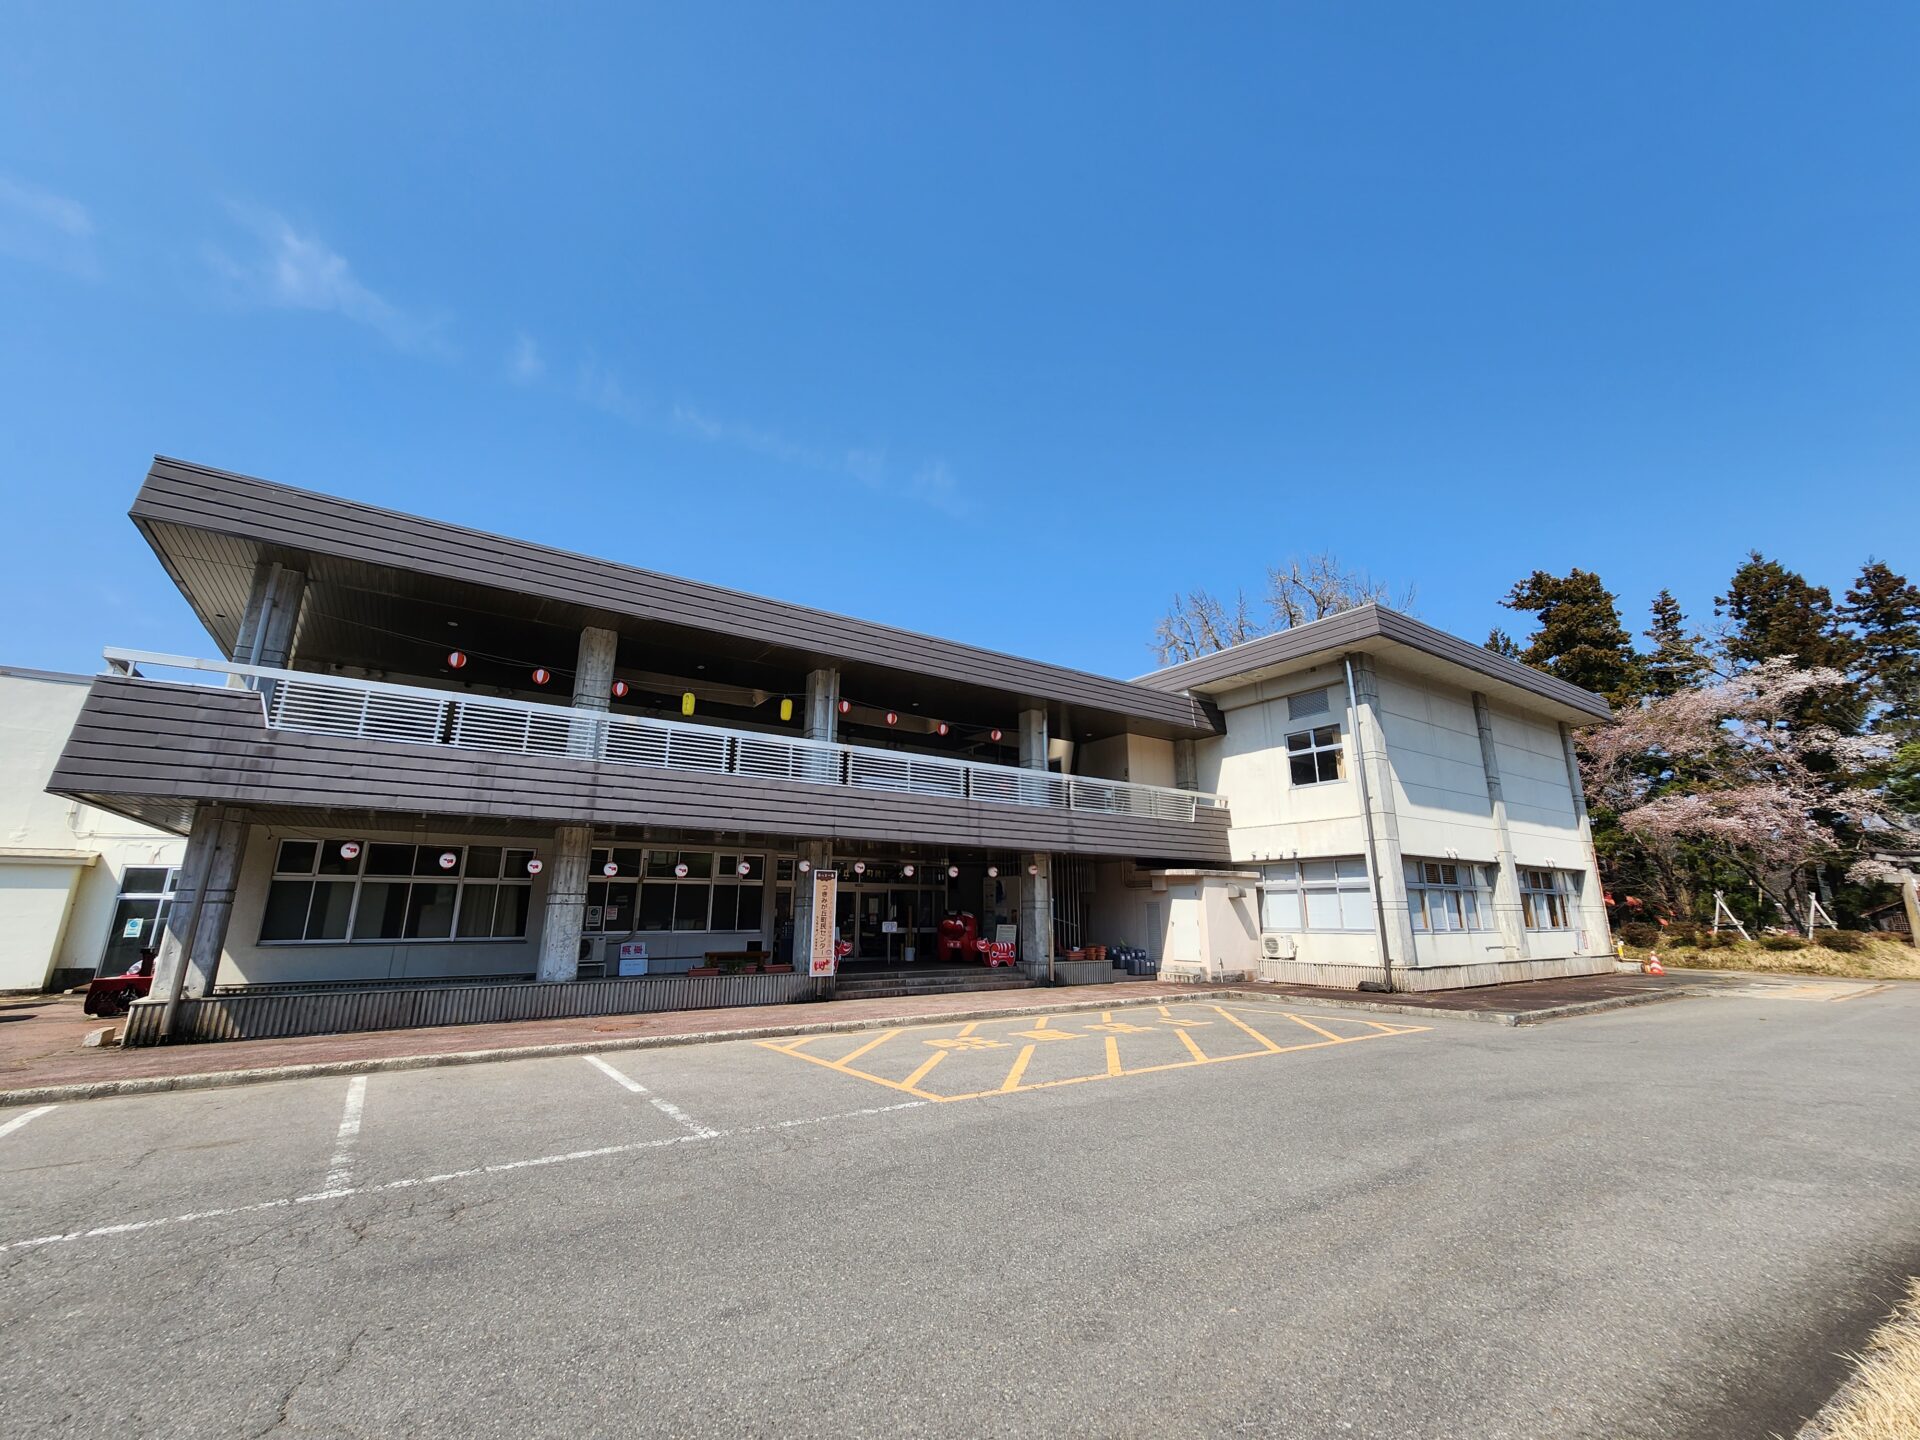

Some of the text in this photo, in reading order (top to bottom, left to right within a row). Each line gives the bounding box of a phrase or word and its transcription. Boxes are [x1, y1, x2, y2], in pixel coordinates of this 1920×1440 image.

[819, 884, 829, 956] つきみが丘町民センター
